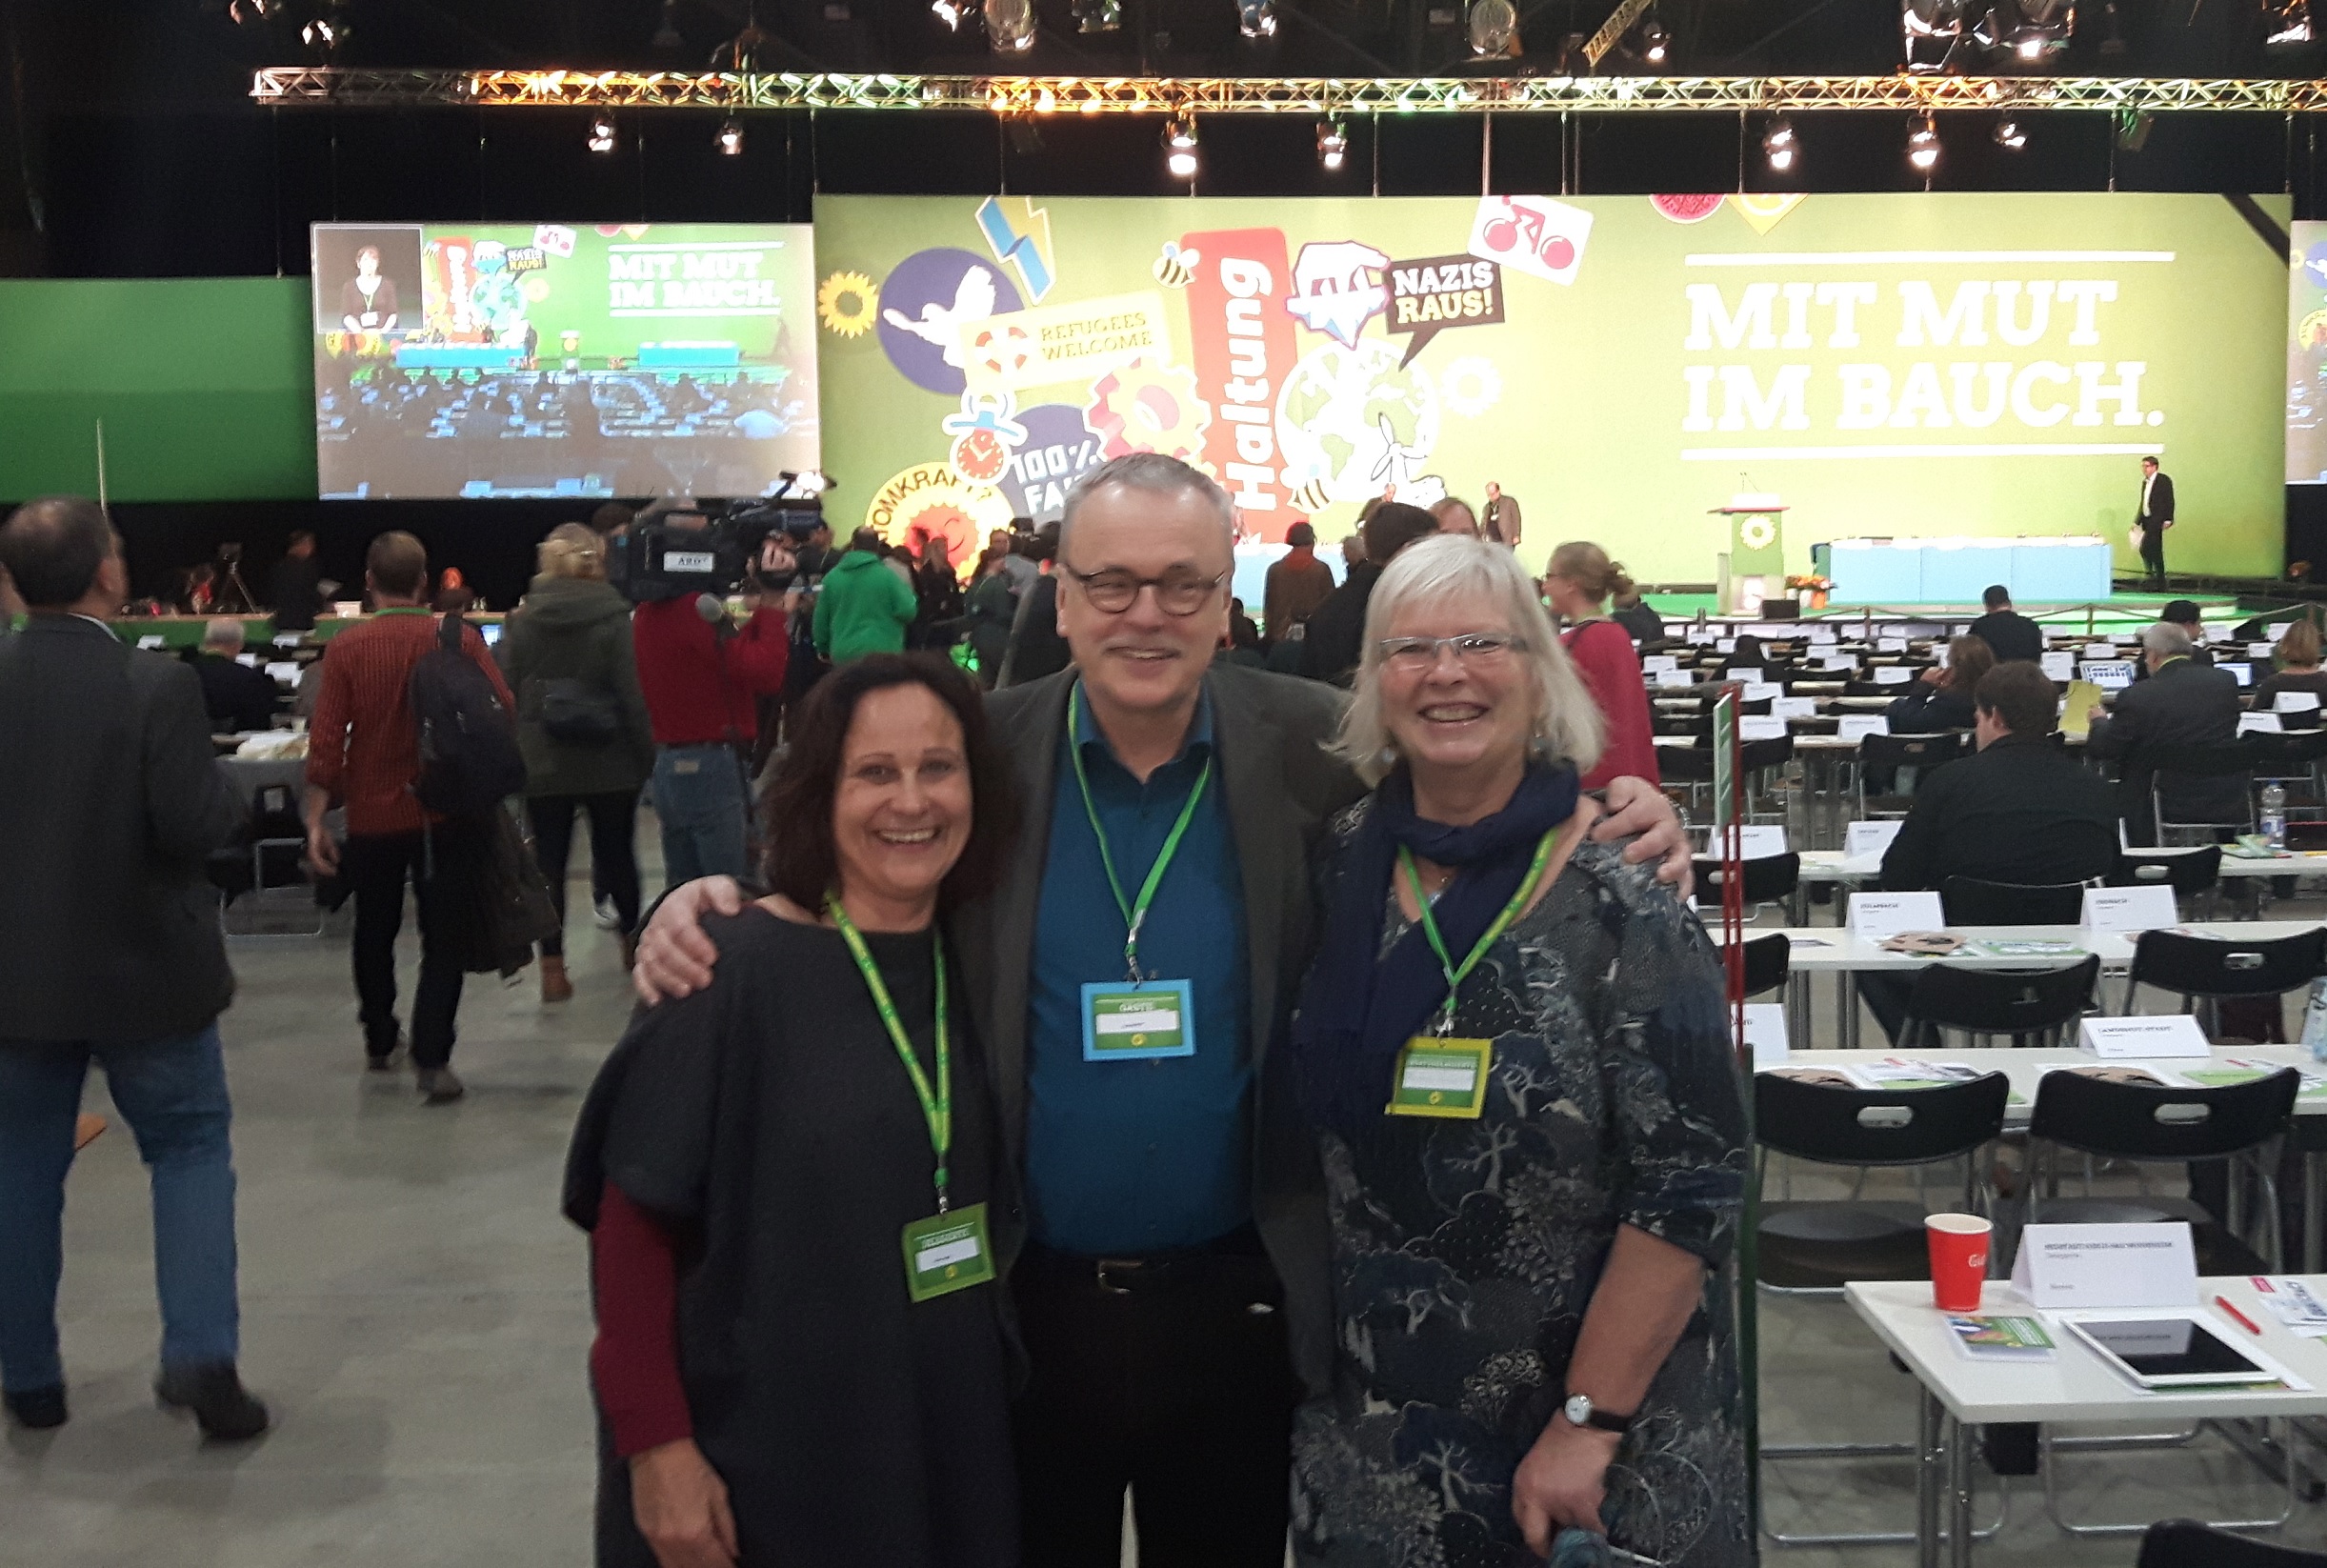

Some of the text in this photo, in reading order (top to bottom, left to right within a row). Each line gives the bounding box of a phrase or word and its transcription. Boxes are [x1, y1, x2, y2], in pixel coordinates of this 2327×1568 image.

[608, 251, 763, 280] MIT MUT
[1392, 260, 1494, 296] NAZIS
[609, 281, 655, 308] IM
[1395, 288, 1494, 324] RAUS!
[1040, 312, 1147, 341] REFUGEES
[1684, 280, 2119, 350] MIT MUT
[1042, 331, 1153, 360] WELCOME
[1220, 256, 1276, 511] Haltung
[1682, 361, 2165, 432] IM BAUCH.
[1011, 440, 1098, 484] 100%
[1024, 472, 1088, 515] FA
